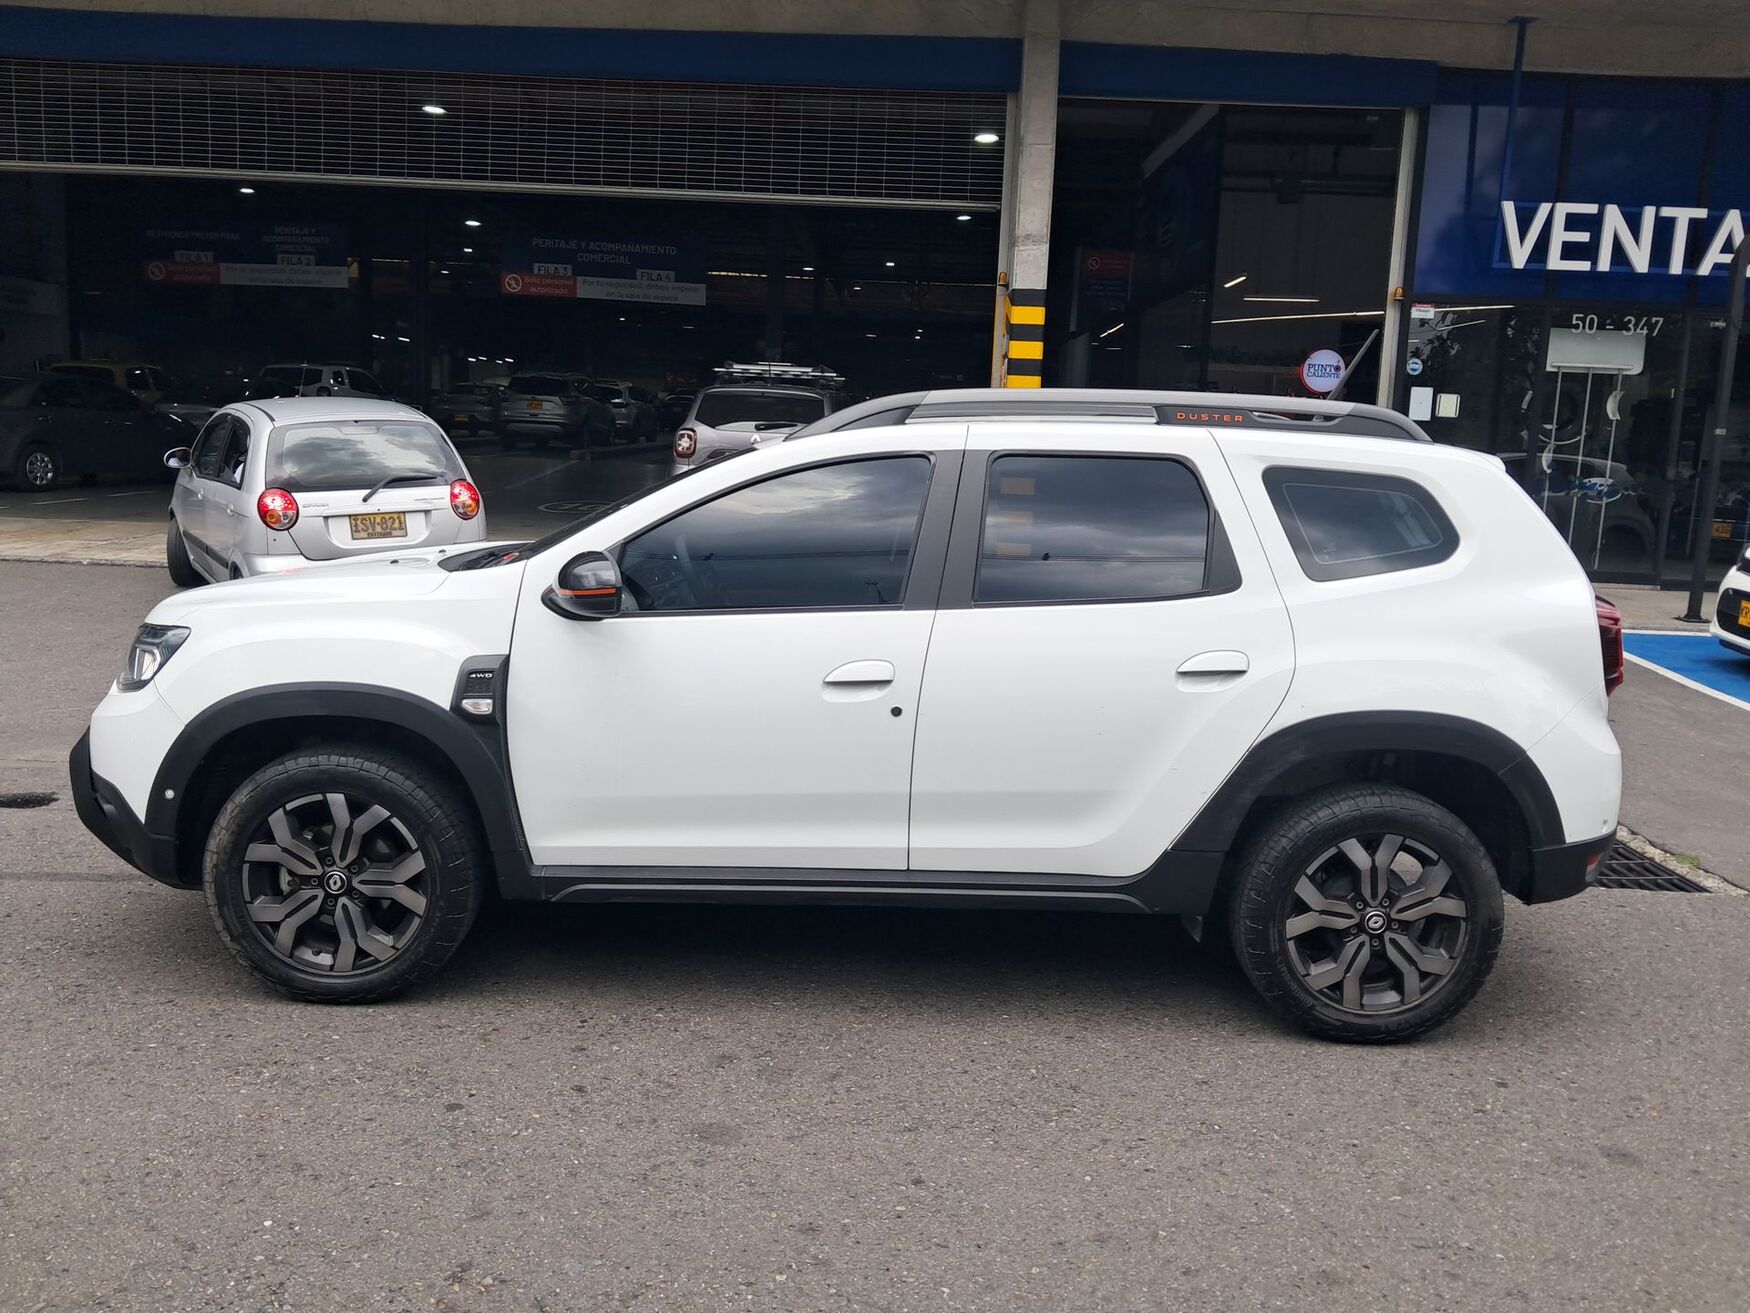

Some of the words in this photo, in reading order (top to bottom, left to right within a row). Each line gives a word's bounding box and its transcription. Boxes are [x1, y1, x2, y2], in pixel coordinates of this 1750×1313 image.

[532, 238, 578, 249] PERITAJE
[580, 240, 587, 249] Y
[1501, 200, 1750, 278] VENTA
[577, 252, 632, 264] COMERCIAL
[537, 265, 560, 275] FILA
[562, 266, 569, 275] 3
[640, 271, 663, 281] FILA
[665, 273, 671, 281] 4
[1571, 313, 1598, 334] 50
[1622, 316, 1665, 336] 347
[1177, 412, 1244, 422] DUSTER
